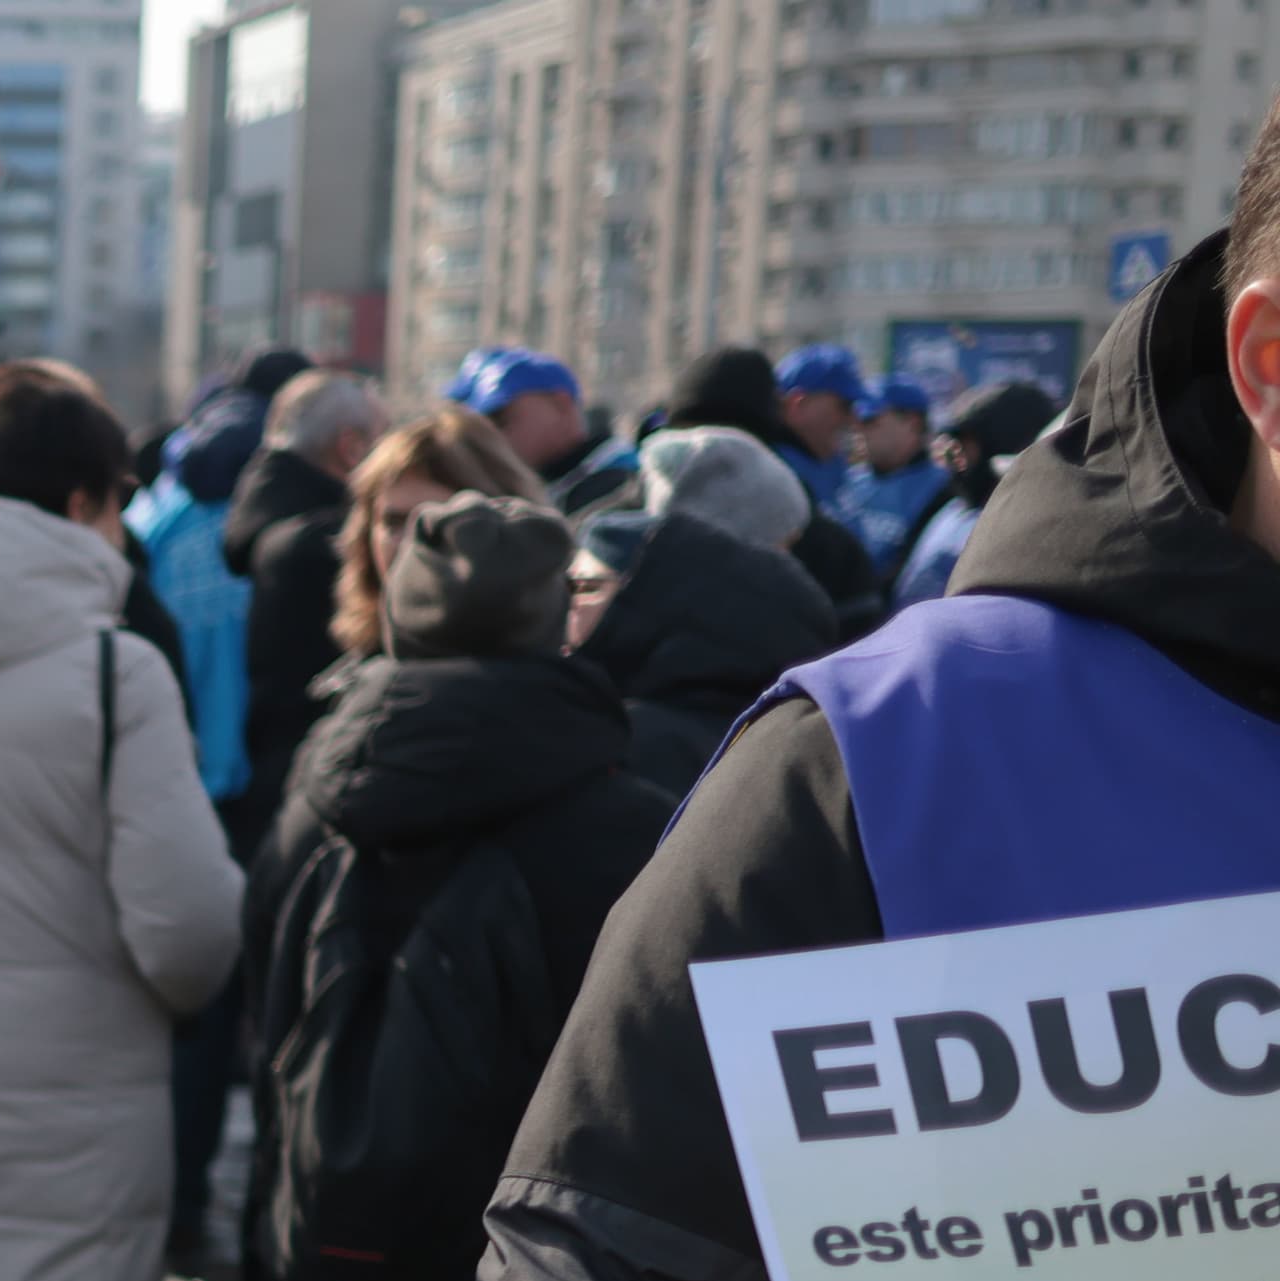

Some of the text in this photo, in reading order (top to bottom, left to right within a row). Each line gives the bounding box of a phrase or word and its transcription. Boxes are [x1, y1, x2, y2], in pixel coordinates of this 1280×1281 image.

[771, 972, 1280, 1142] EDUC
[813, 1172, 1280, 1267] este priorita
